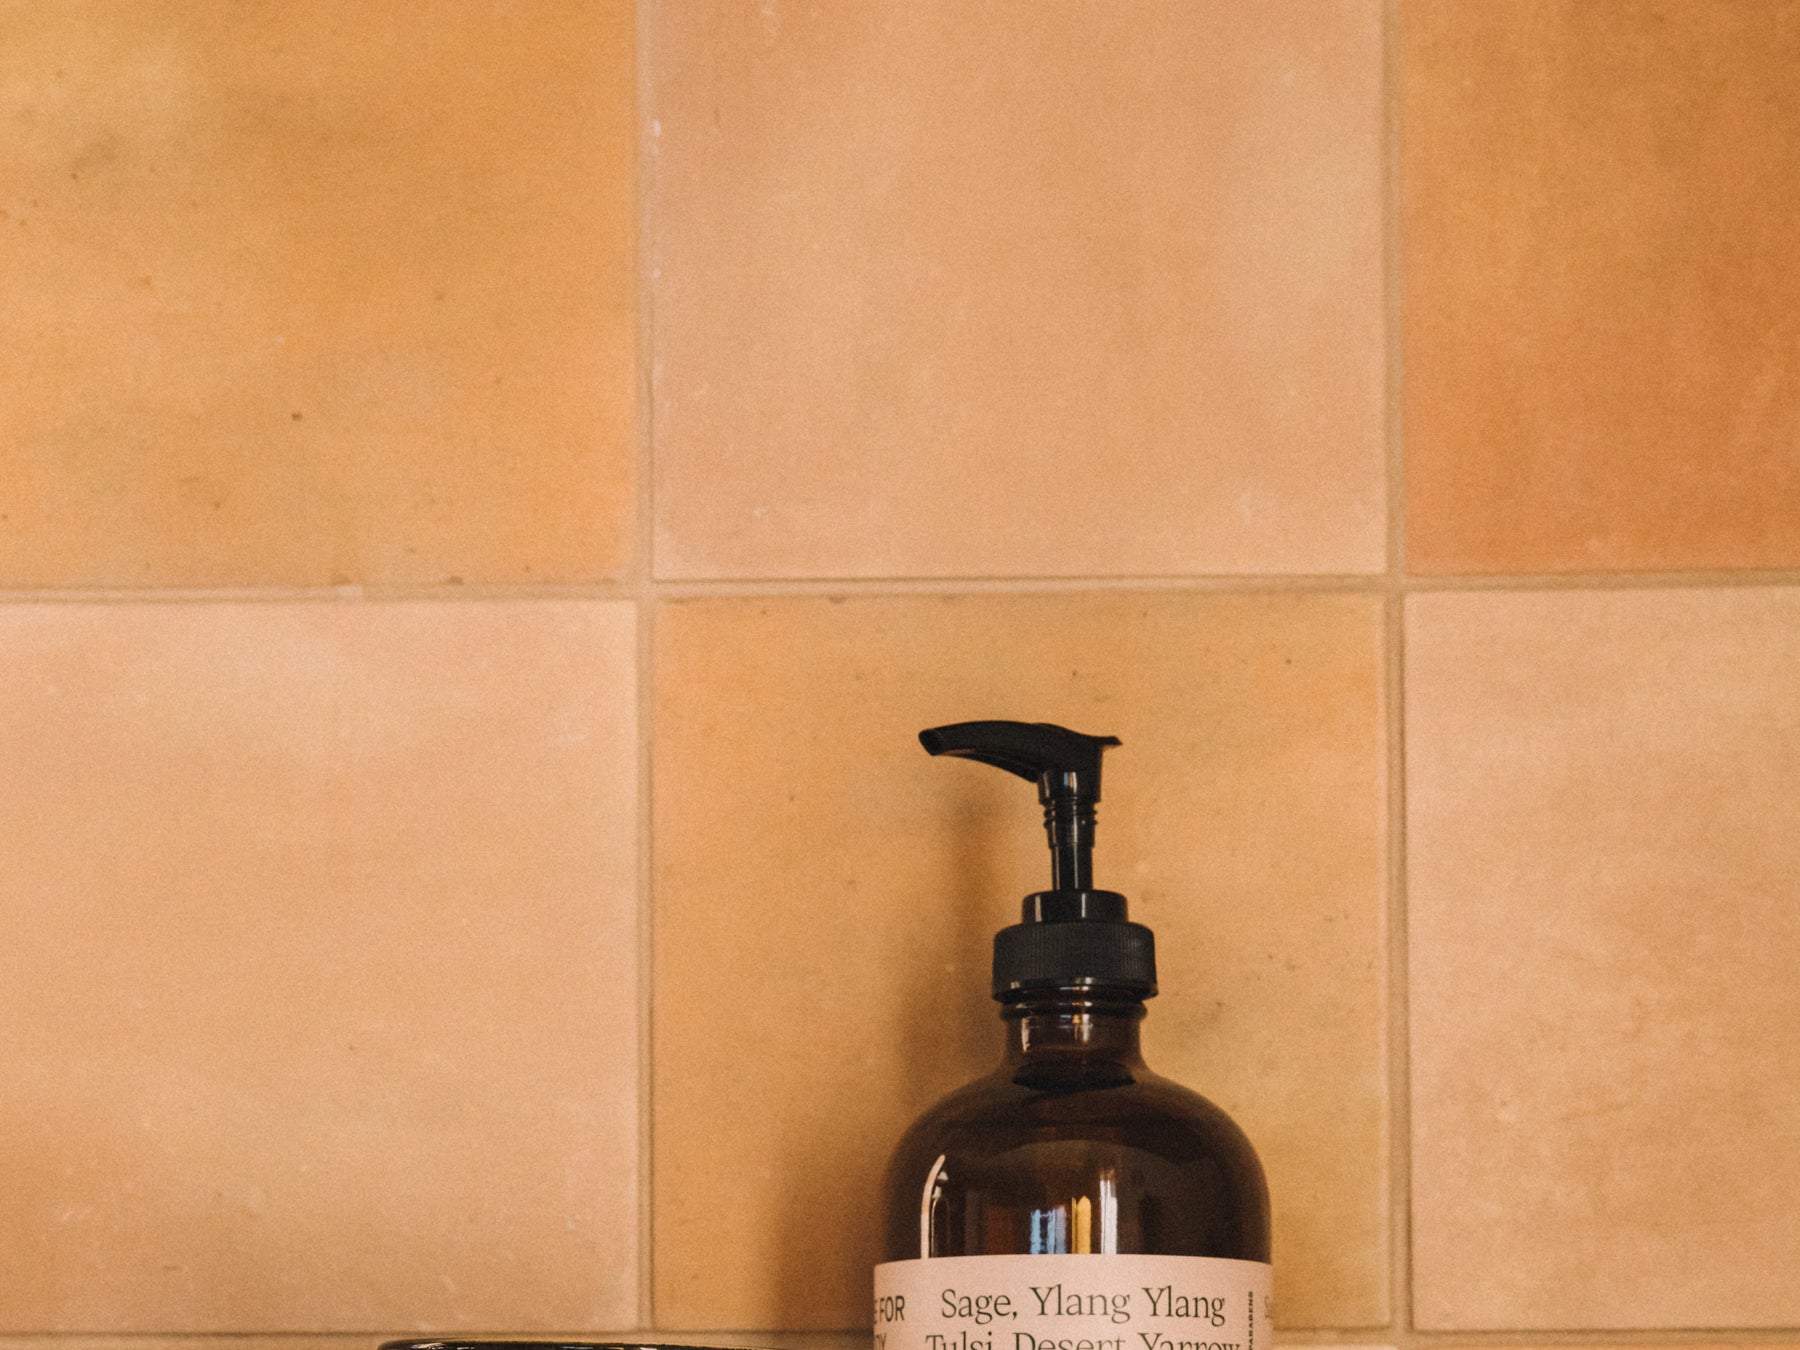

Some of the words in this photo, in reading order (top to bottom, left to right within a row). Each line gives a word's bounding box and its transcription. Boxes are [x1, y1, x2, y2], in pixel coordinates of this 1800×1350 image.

[942, 1289, 1017, 1324] Sage,
[1029, 1284, 1130, 1323] Ylang
[1142, 1287, 1225, 1326] Ylang
